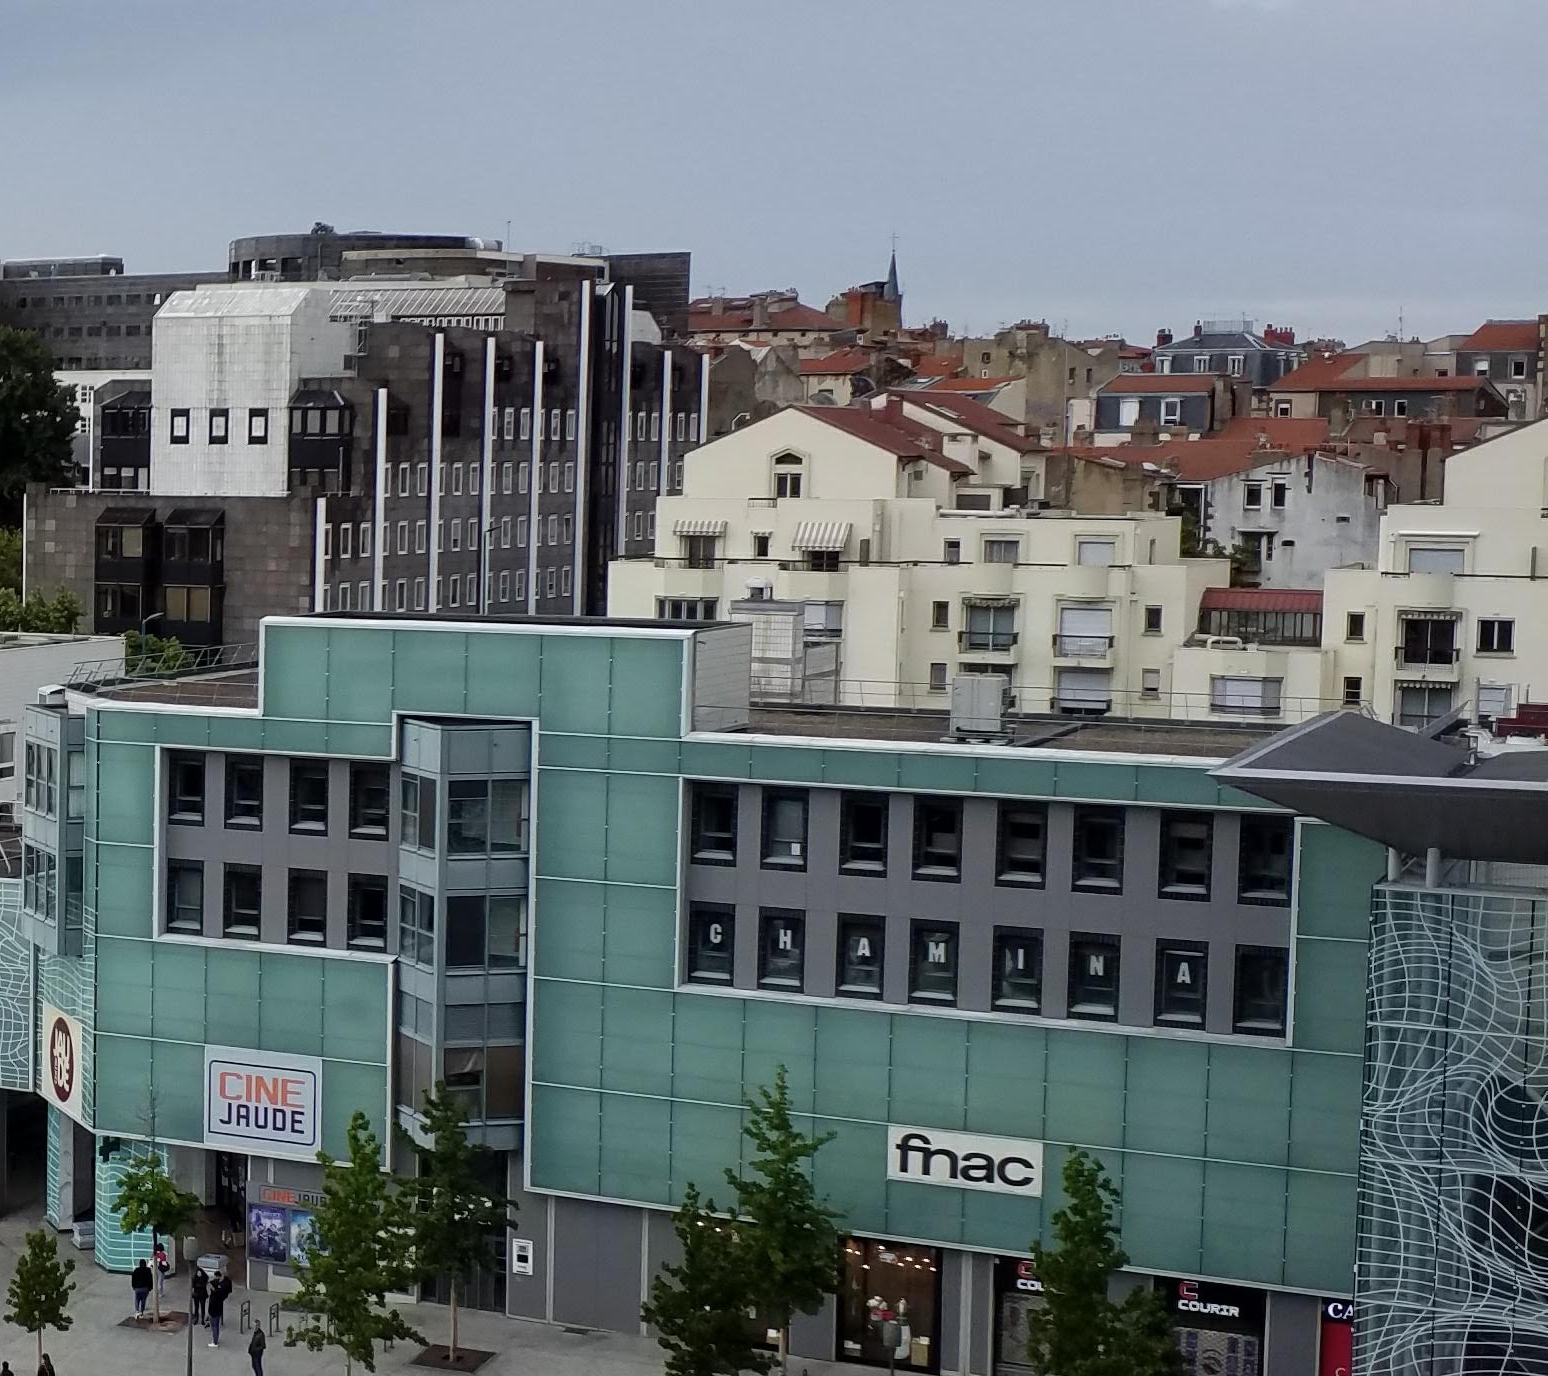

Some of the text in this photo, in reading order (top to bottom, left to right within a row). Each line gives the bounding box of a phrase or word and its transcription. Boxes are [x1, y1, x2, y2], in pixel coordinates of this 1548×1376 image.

[219, 1071, 305, 1109] CINE
[219, 1102, 305, 1134] JAUDE
[895, 1133, 1034, 1187] fnac
[295, 1193, 329, 1207] JAUD
[1177, 1299, 1240, 1318] COURIR
